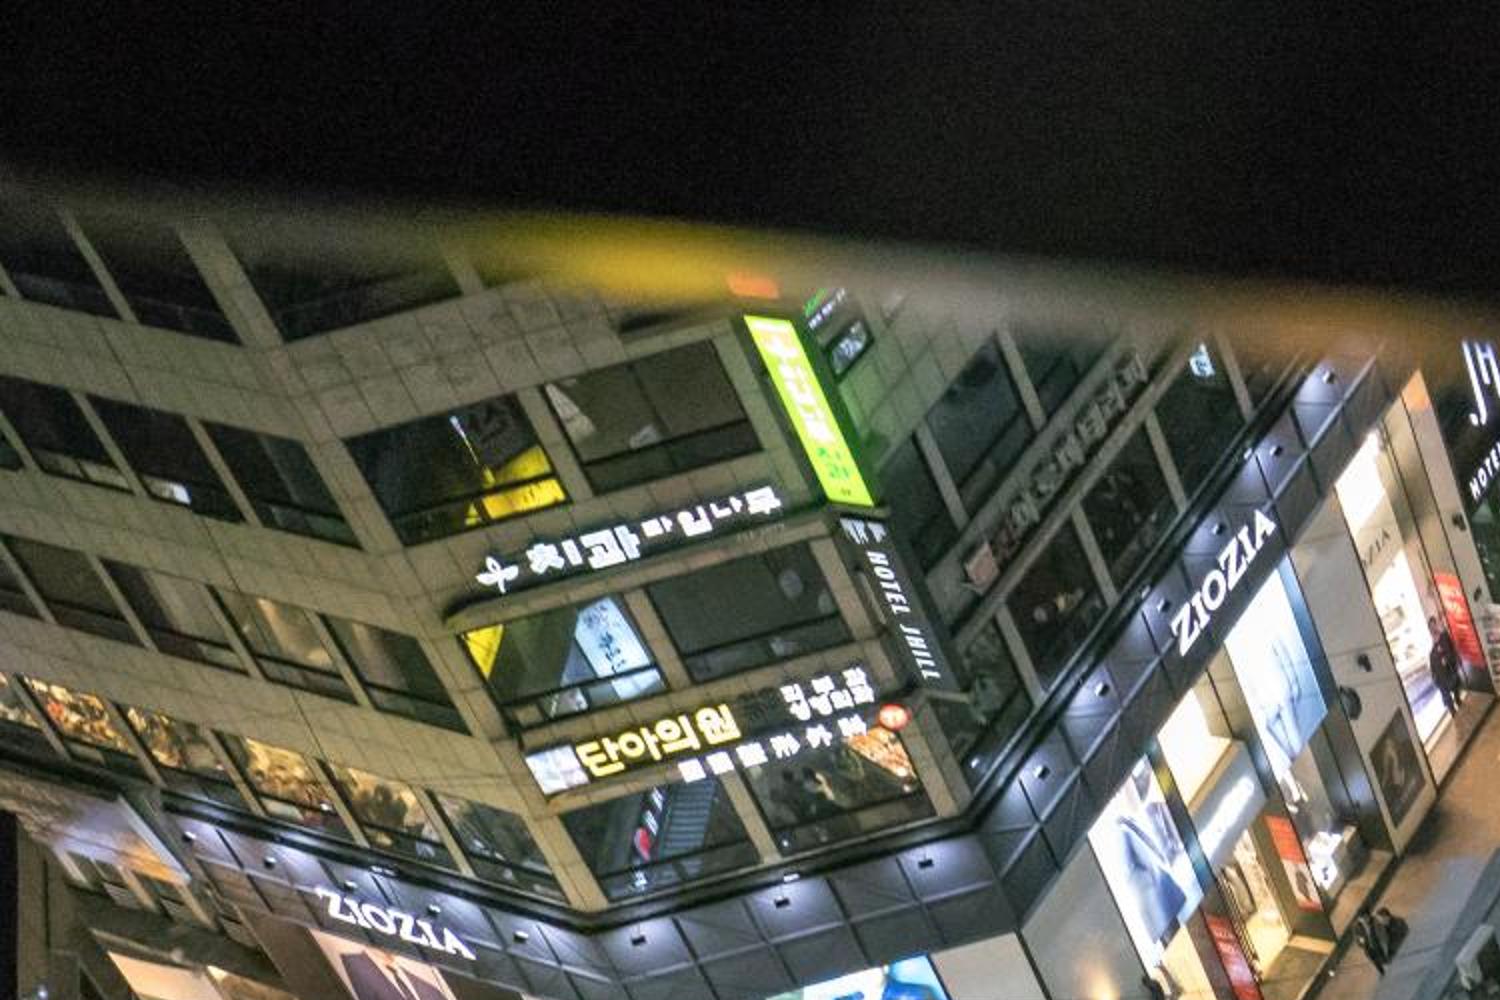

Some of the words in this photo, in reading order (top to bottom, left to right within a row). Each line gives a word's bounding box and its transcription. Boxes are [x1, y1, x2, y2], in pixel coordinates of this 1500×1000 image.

[526, 525, 641, 574] 치과
[1169, 509, 1277, 658] ZIOZIA
[866, 550, 911, 615] HOTEL
[899, 623, 941, 680] JHILL
[576, 703, 741, 778] 단아의원
[315, 886, 477, 961] ZIOZIA
